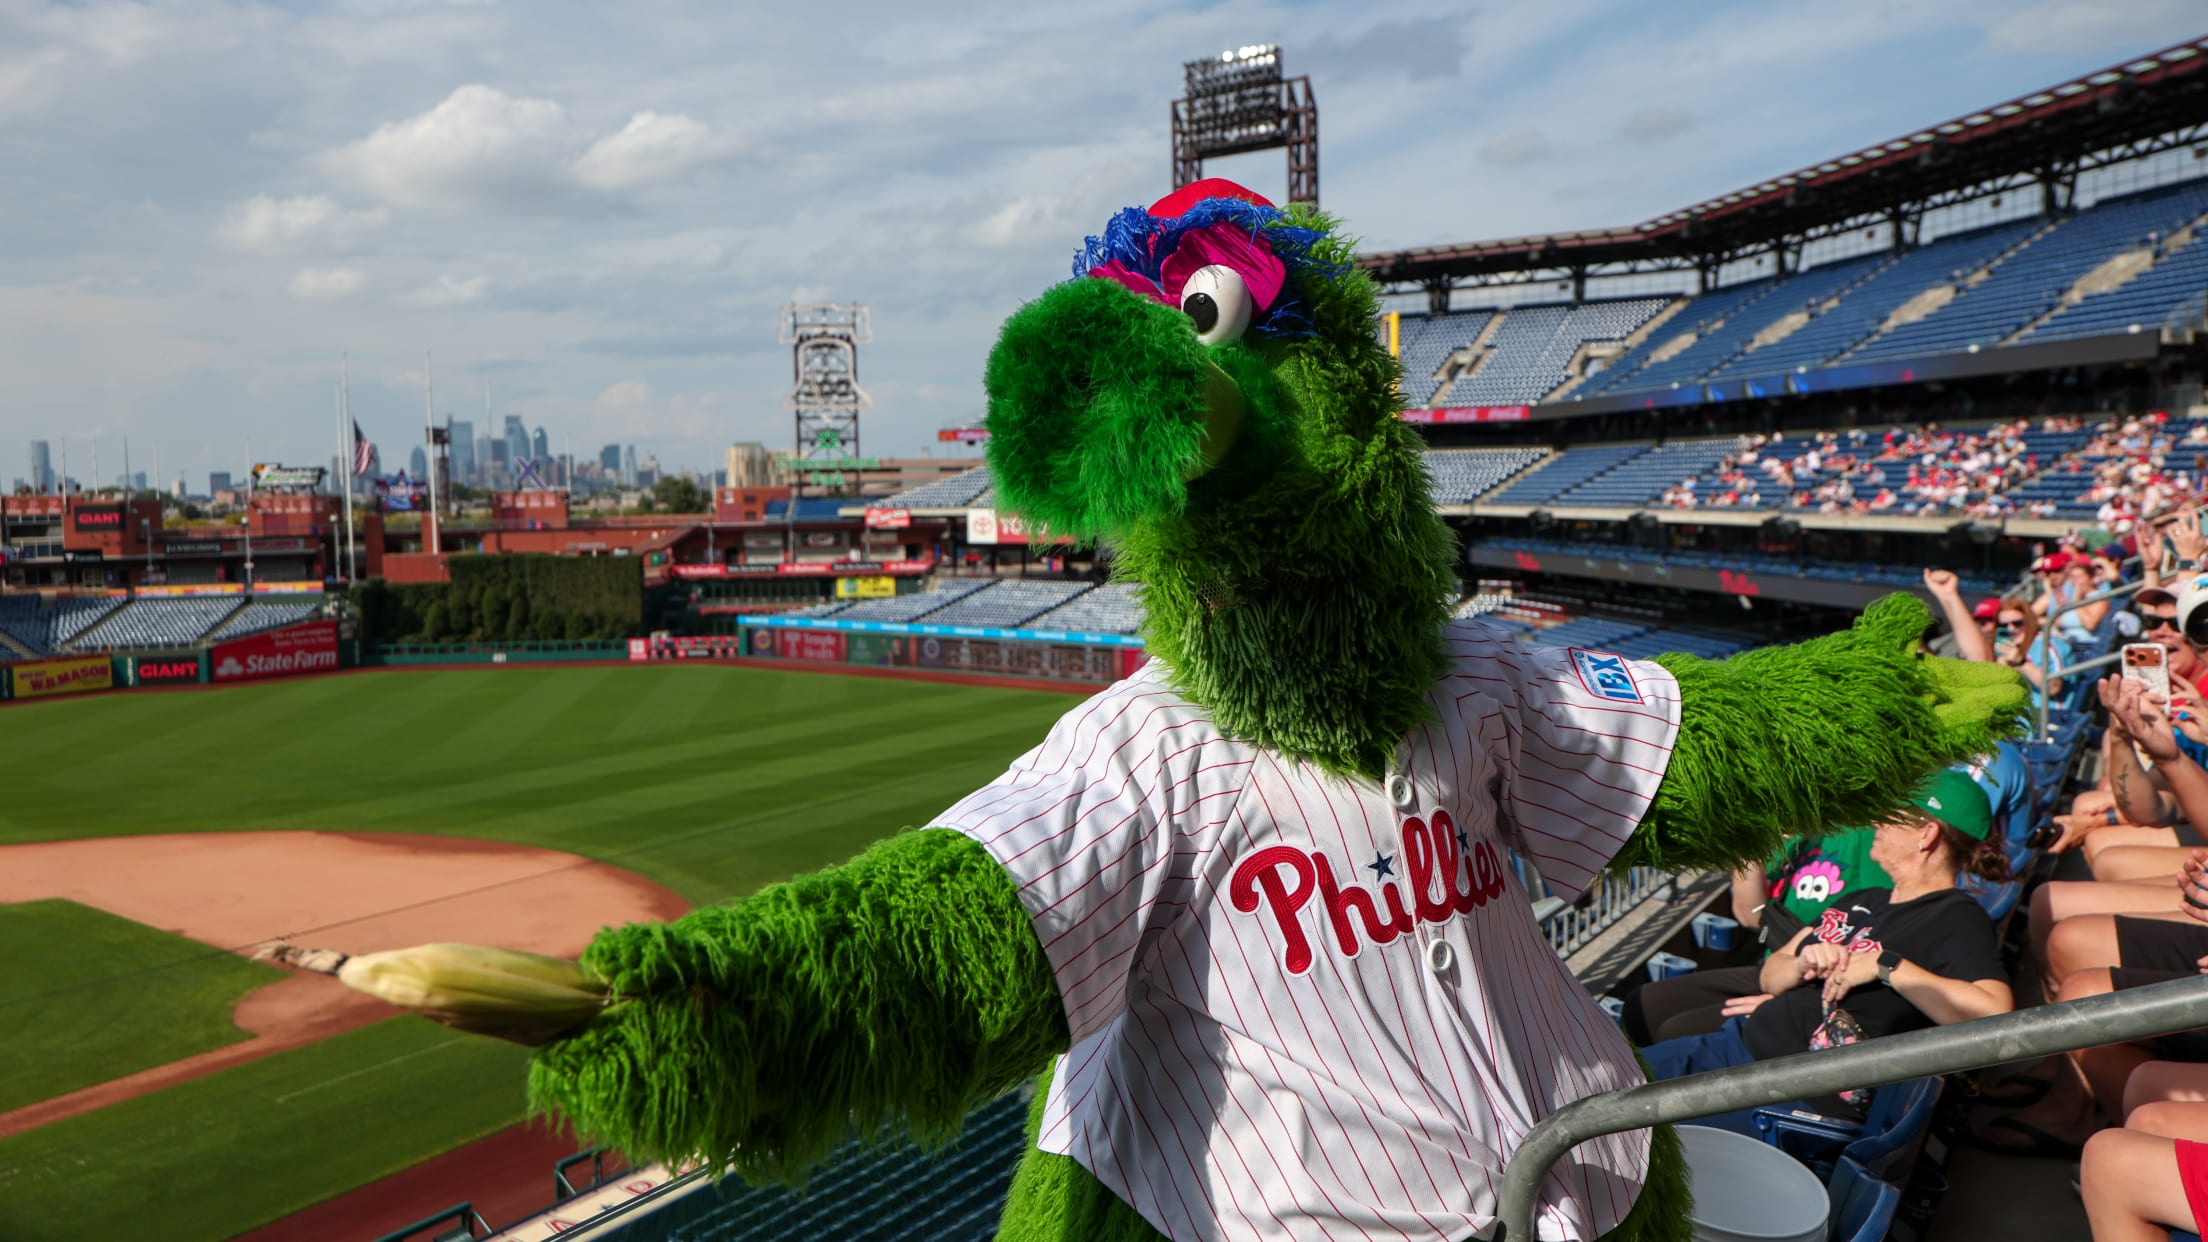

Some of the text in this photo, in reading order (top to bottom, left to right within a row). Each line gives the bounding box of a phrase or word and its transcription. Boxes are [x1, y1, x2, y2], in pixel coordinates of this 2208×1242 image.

[78, 511, 122, 525] GIANT
[139, 662, 199, 684] GIANT
[1587, 655, 1638, 701] IBX
[1229, 806, 1506, 976] Phillies
